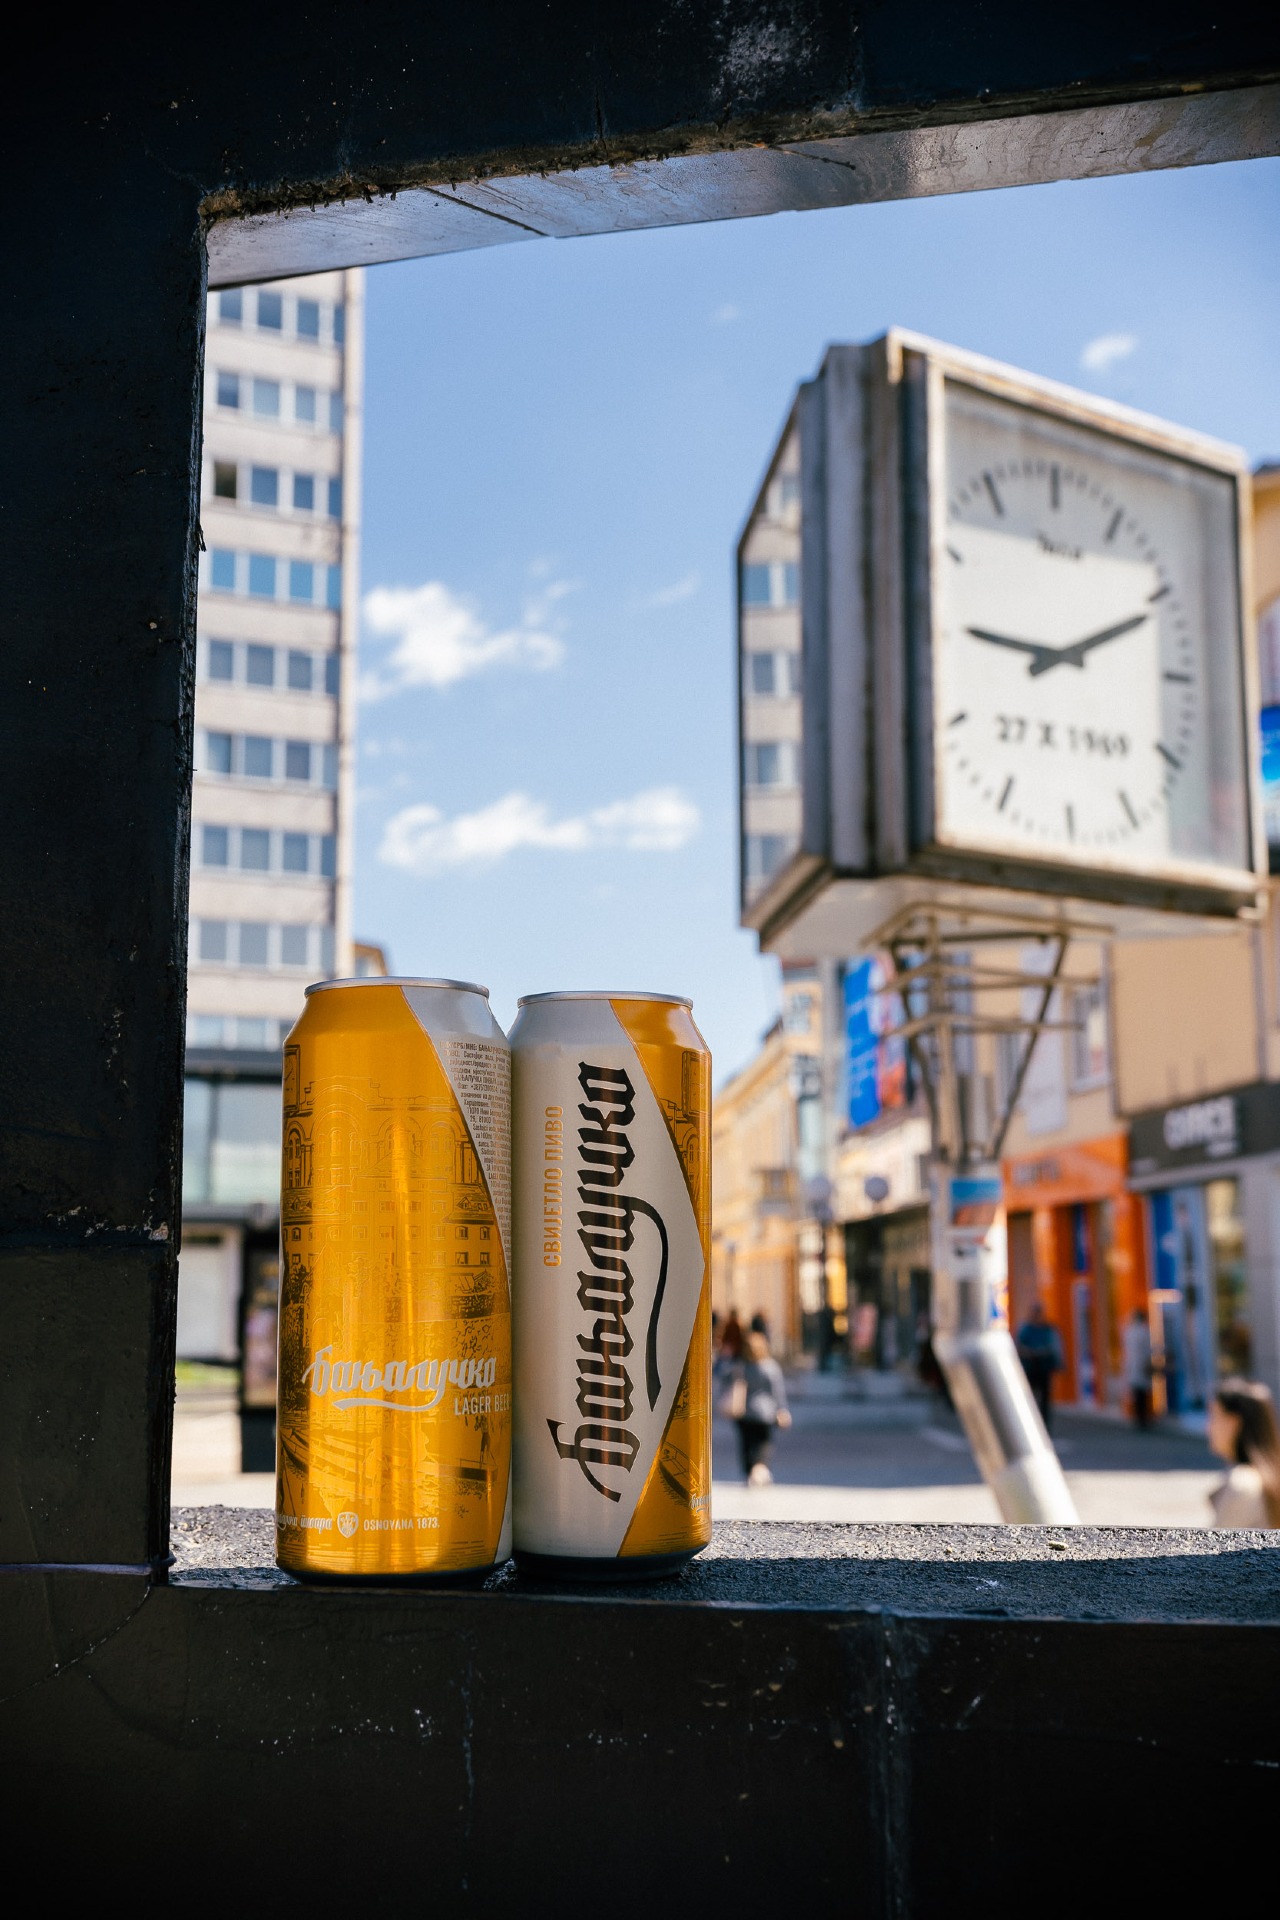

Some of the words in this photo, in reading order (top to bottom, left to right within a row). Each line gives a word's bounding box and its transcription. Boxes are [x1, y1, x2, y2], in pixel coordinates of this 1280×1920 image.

[996, 714, 1027, 743] 27
[543, 1105, 564, 1161] ПИВО
[543, 1167, 564, 1268] СВИЈЕТЛО
[454, 1395, 492, 1416] LAGER
[363, 1518, 414, 1531] OSNOVANA
[416, 1517, 441, 1529] 1873.
